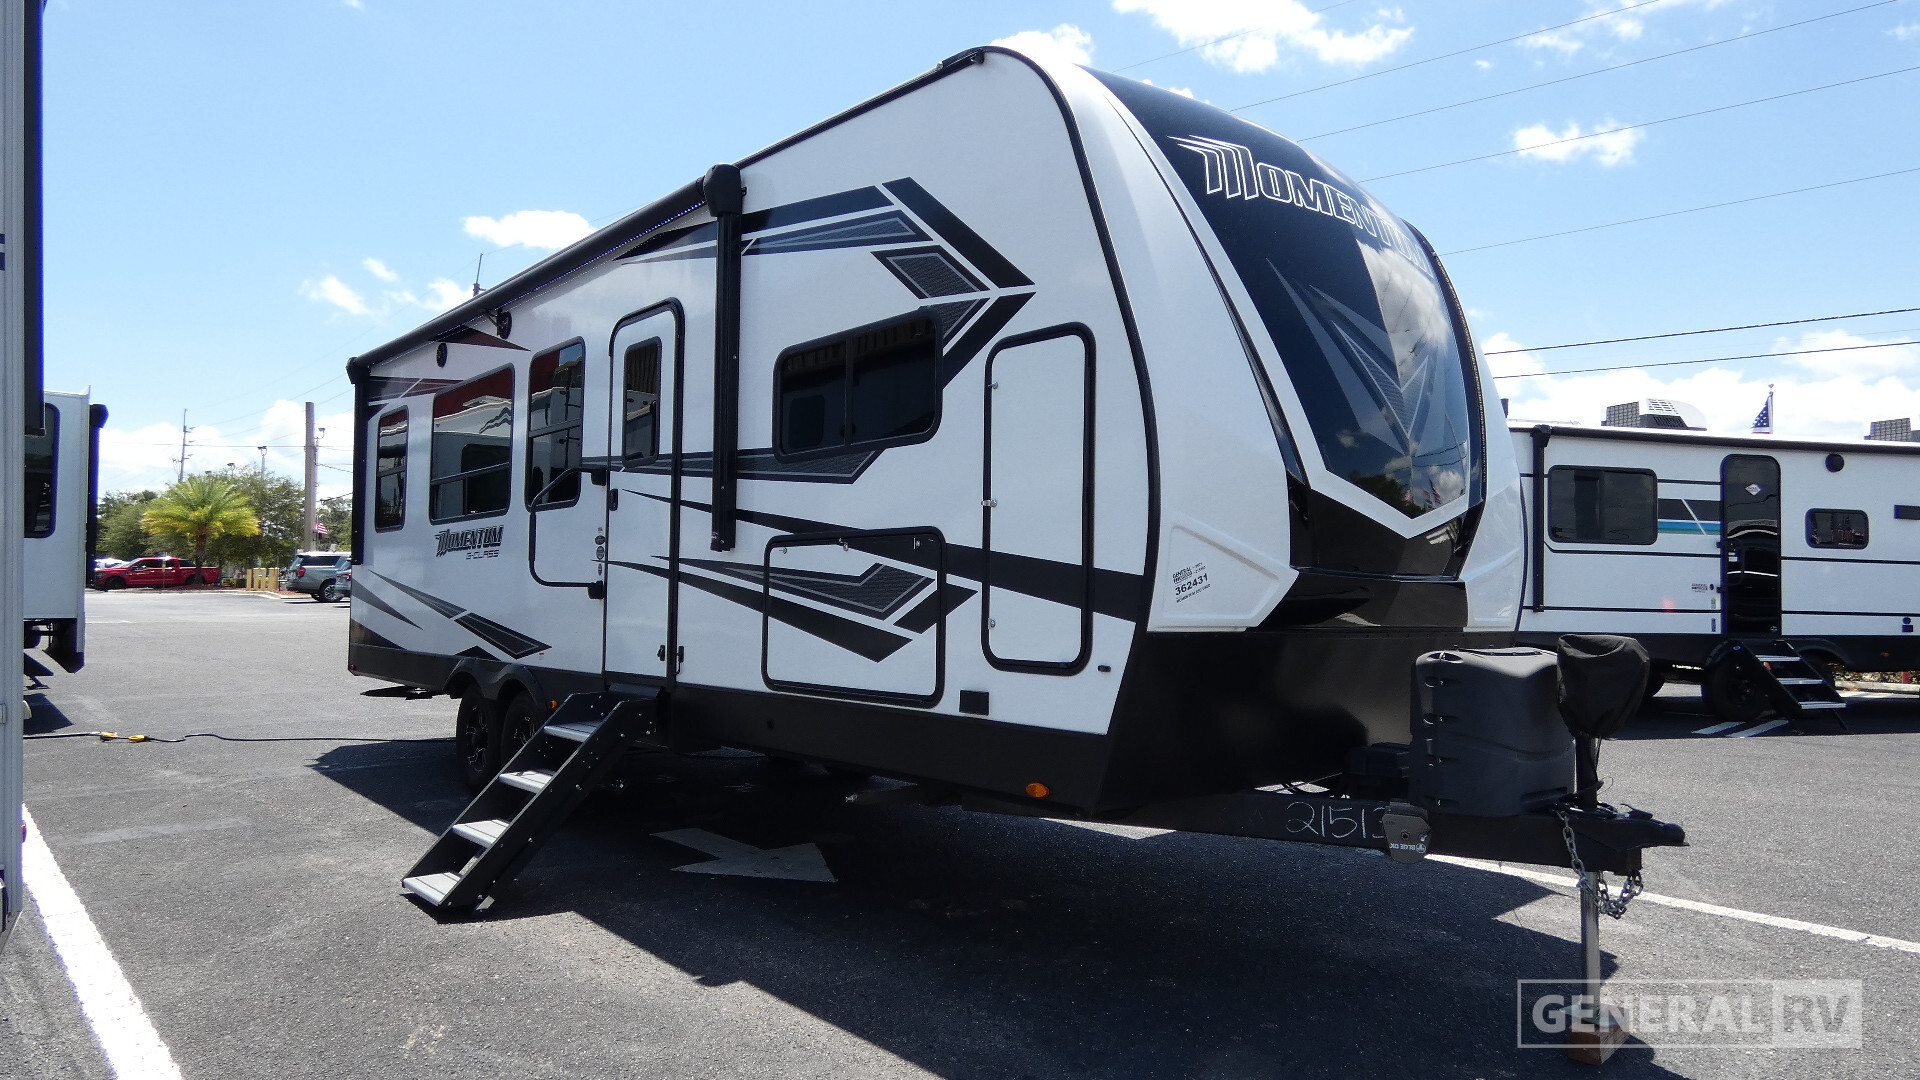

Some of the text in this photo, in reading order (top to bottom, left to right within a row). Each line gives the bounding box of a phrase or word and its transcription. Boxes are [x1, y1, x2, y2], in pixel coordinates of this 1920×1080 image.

[1166, 134, 1434, 278] MOMENTUM
[435, 525, 504, 557] MOMENTUM
[1175, 572, 1208, 596] 362431
[1389, 842, 1416, 851] BLUE OX
